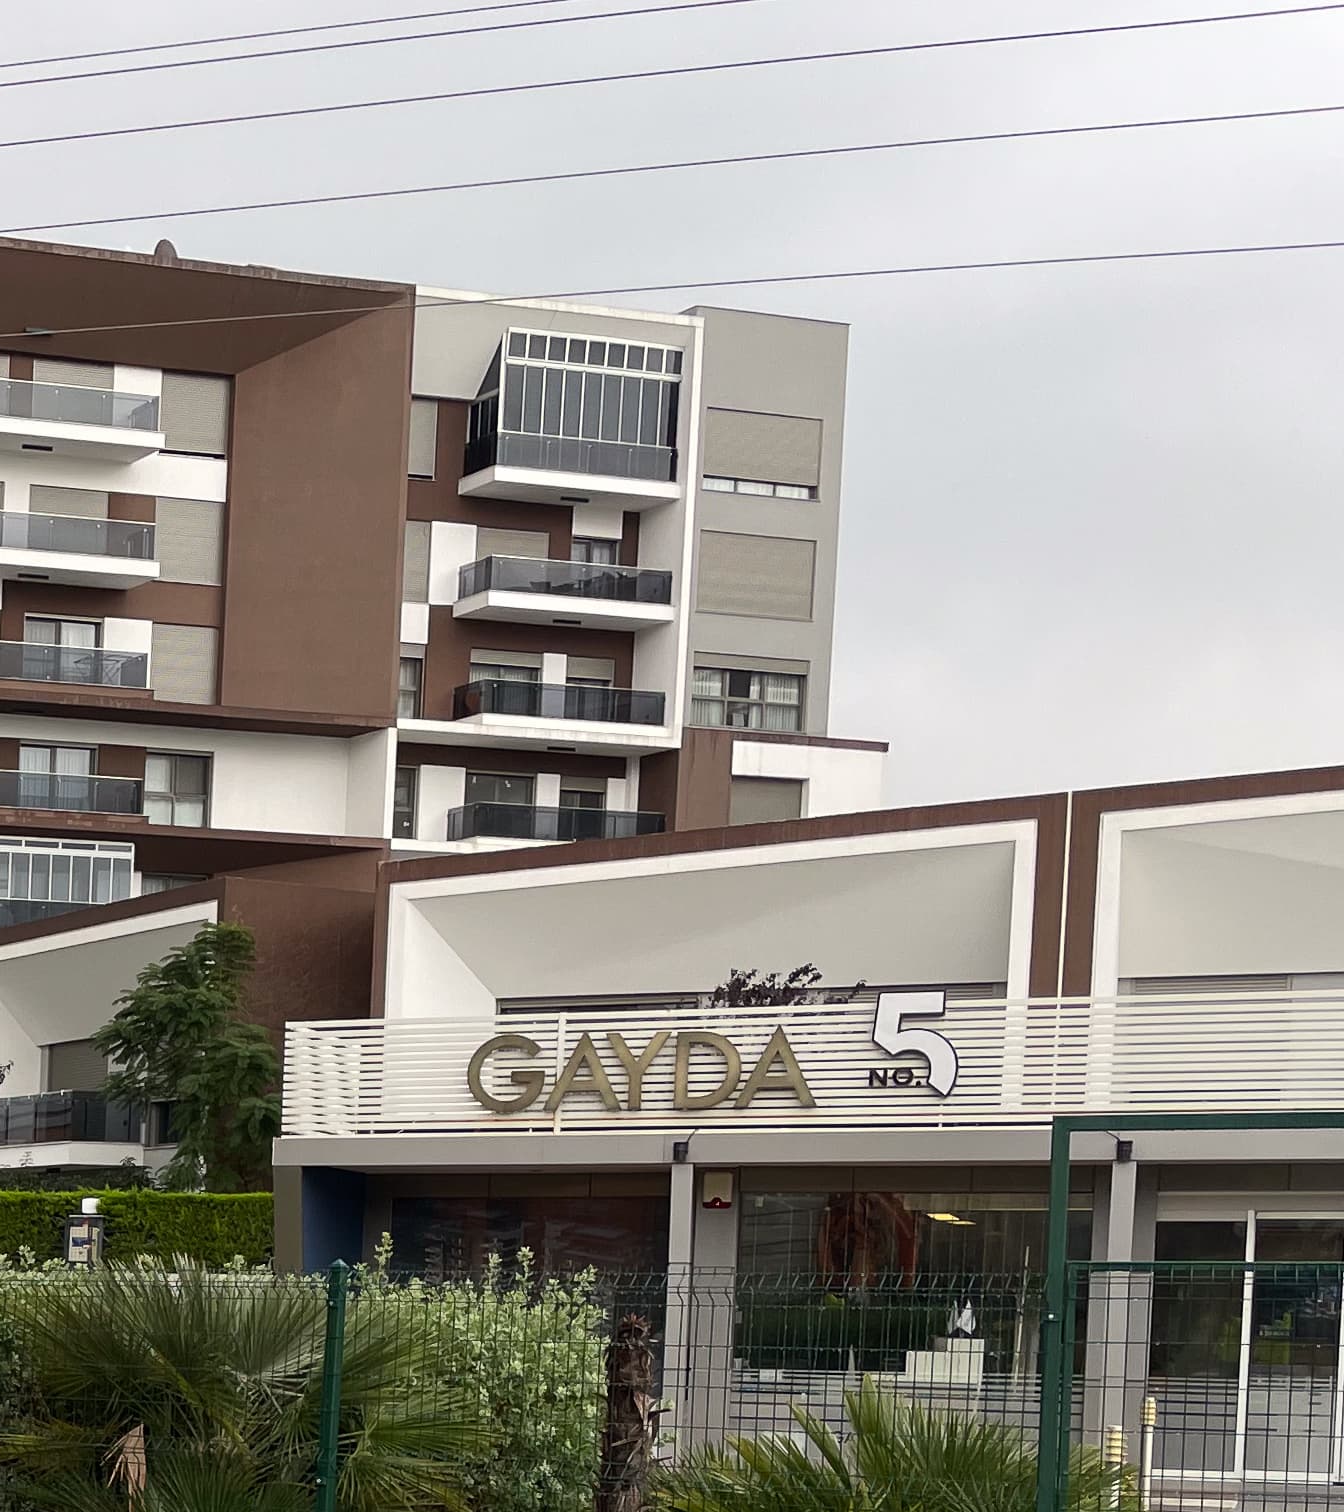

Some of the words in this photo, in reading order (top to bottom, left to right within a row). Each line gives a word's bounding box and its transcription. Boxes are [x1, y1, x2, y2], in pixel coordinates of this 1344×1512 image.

[467, 1023, 817, 1115] GAYDA
[868, 1068, 922, 1089] NO.
[872, 991, 959, 1098] 5
